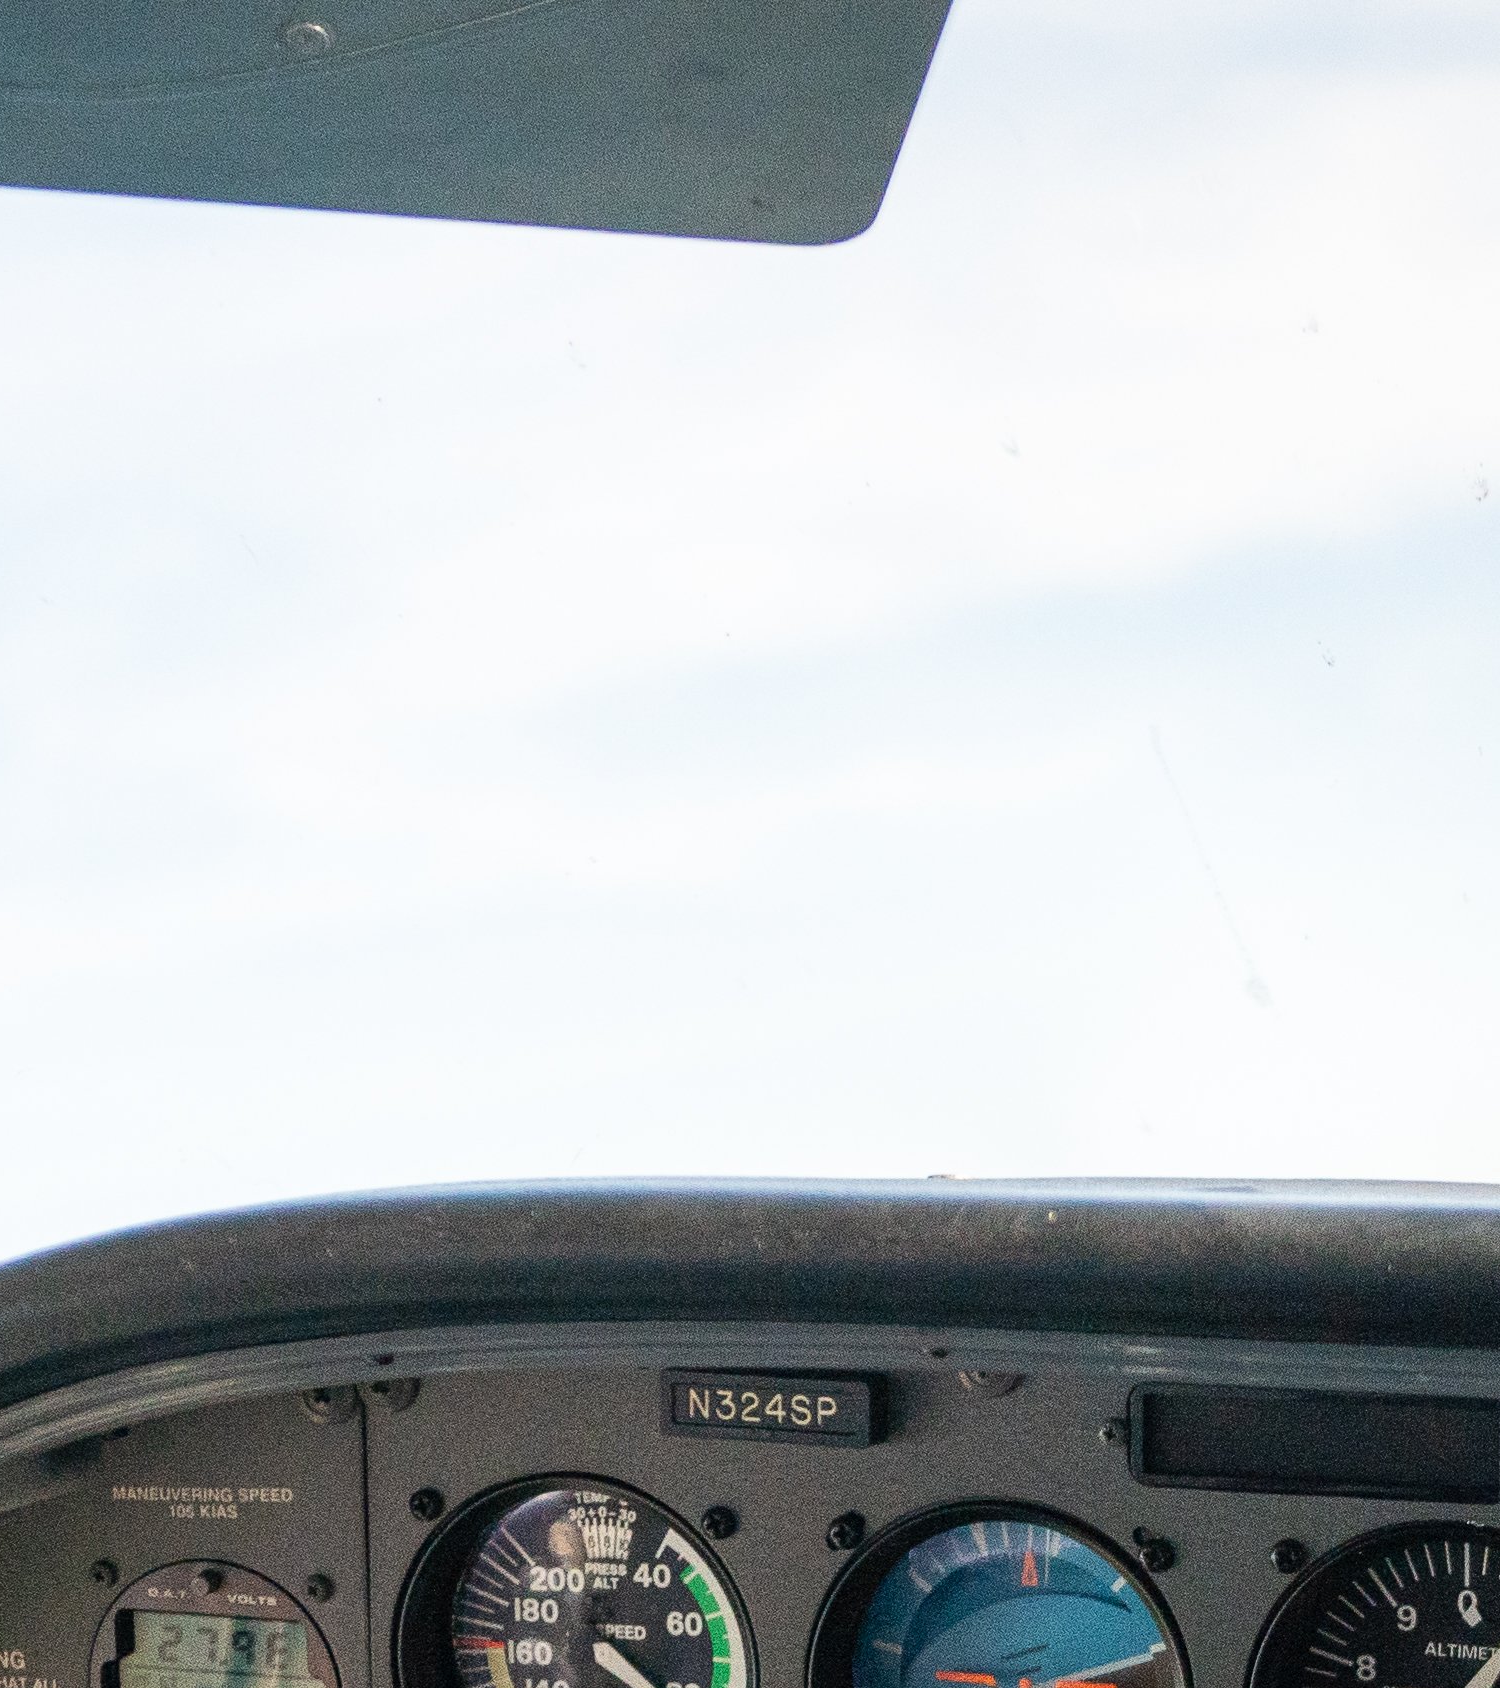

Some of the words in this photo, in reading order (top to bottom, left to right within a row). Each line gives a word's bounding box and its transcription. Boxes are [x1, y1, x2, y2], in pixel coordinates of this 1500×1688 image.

[687, 1388, 838, 1426] N324SP
[112, 1486, 233, 1502] MANEUVERING
[238, 1488, 294, 1503] SPEED
[200, 1505, 238, 1519] KIAS
[530, 1566, 584, 1594] 200
[593, 1578, 618, 1591] ALT
[633, 1563, 671, 1589] 40
[514, 1598, 559, 1623] 180
[666, 1611, 702, 1637] 60
[508, 1640, 552, 1665] 160
[1424, 1641, 1500, 1661] ALTIMET
